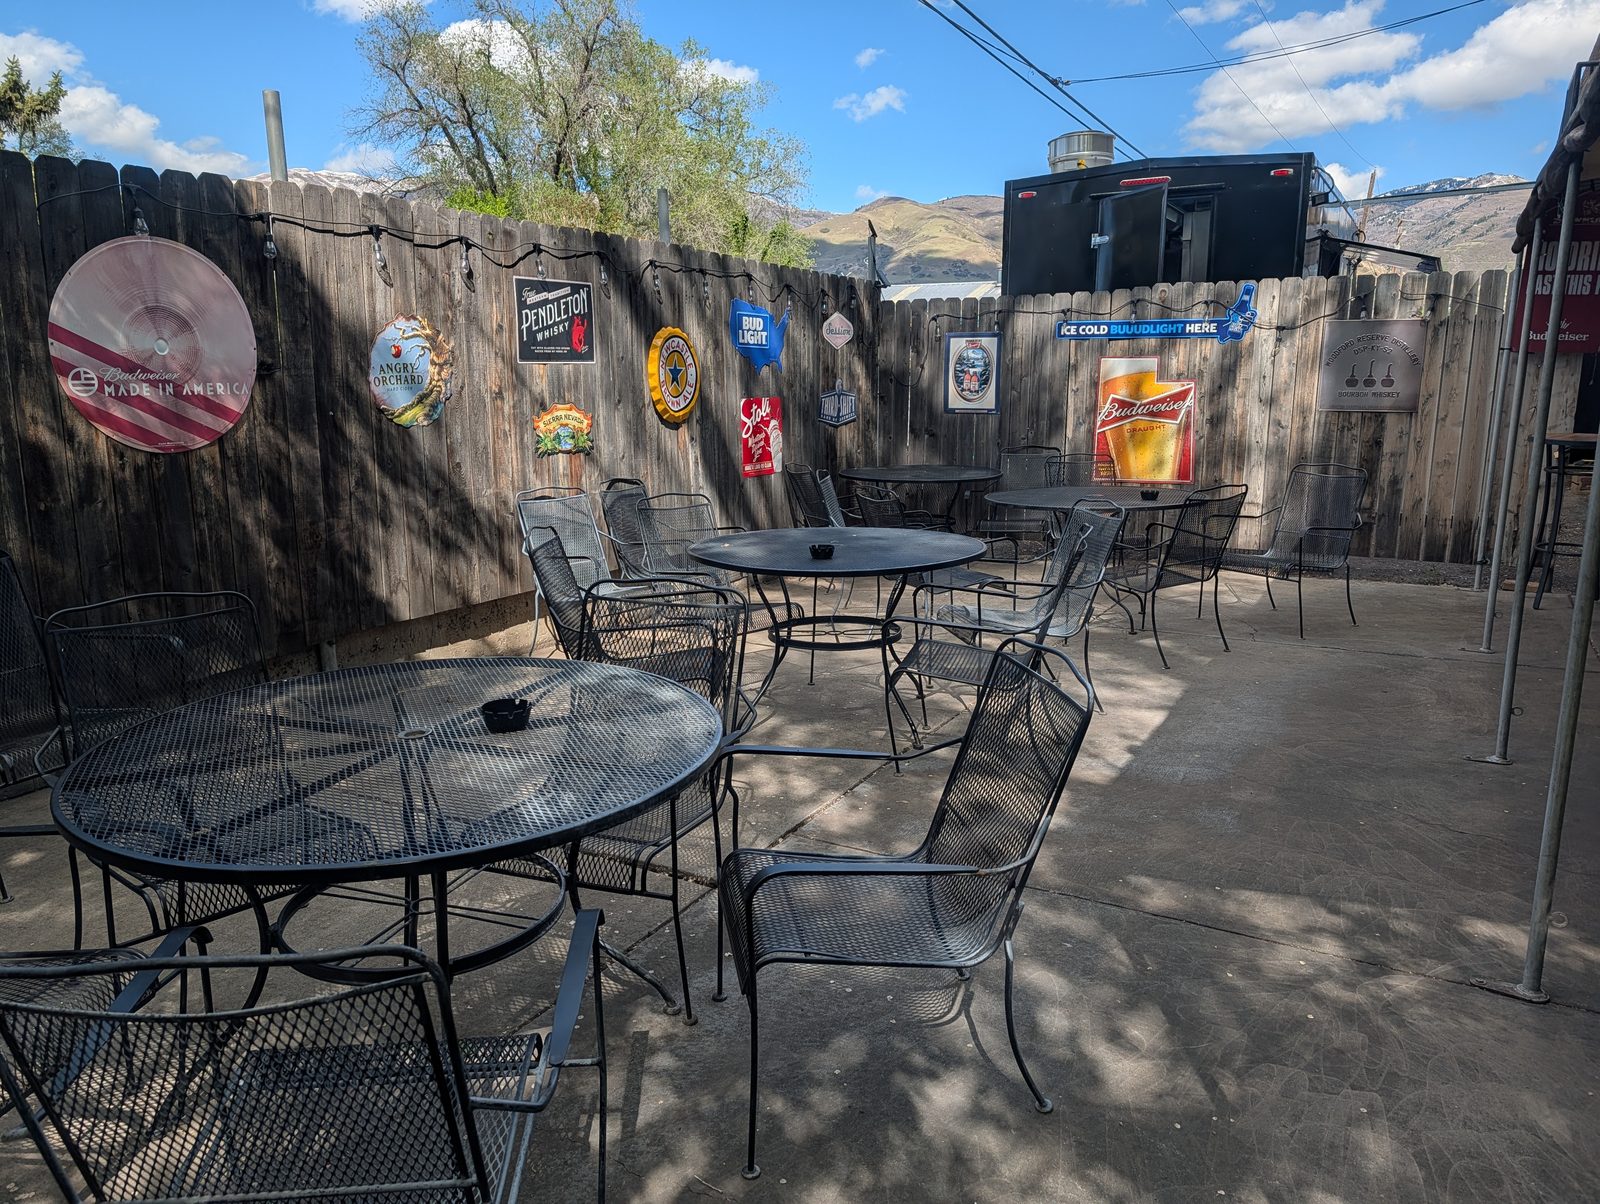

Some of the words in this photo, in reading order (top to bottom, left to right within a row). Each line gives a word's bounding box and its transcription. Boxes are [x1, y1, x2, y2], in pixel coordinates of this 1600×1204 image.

[520, 287, 588, 342] PENDLETON
[742, 316, 764, 330] BUD
[1060, 325, 1077, 335] ICE
[1079, 325, 1108, 335] COLD
[1110, 323, 1184, 334] BUUUDLIGHT
[1186, 322, 1218, 333] HERE
[536, 321, 569, 342] WHISKY
[738, 330, 767, 344] LIGHT
[660, 340, 694, 371] NEWCASTLE
[1325, 339, 1356, 368] WOODFORD
[1357, 332, 1390, 342] RESERVE
[1392, 336, 1422, 367] DISTILLERY
[98, 368, 180, 382] Budweiser
[379, 362, 416, 374] ANGRY
[374, 374, 424, 386] ORCHARD
[104, 383, 150, 396] MADE
[158, 383, 173, 396] IN
[182, 382, 249, 395] AMERICA
[660, 379, 682, 409] BROWN
[682, 382, 694, 403] ALE
[1098, 398, 1194, 421] Budweiser
[542, 414, 564, 428] SIERRA
[564, 413, 584, 426] NEVADA
[740, 398, 770, 438] Stoli
[1126, 424, 1166, 434] DRAUGHT
